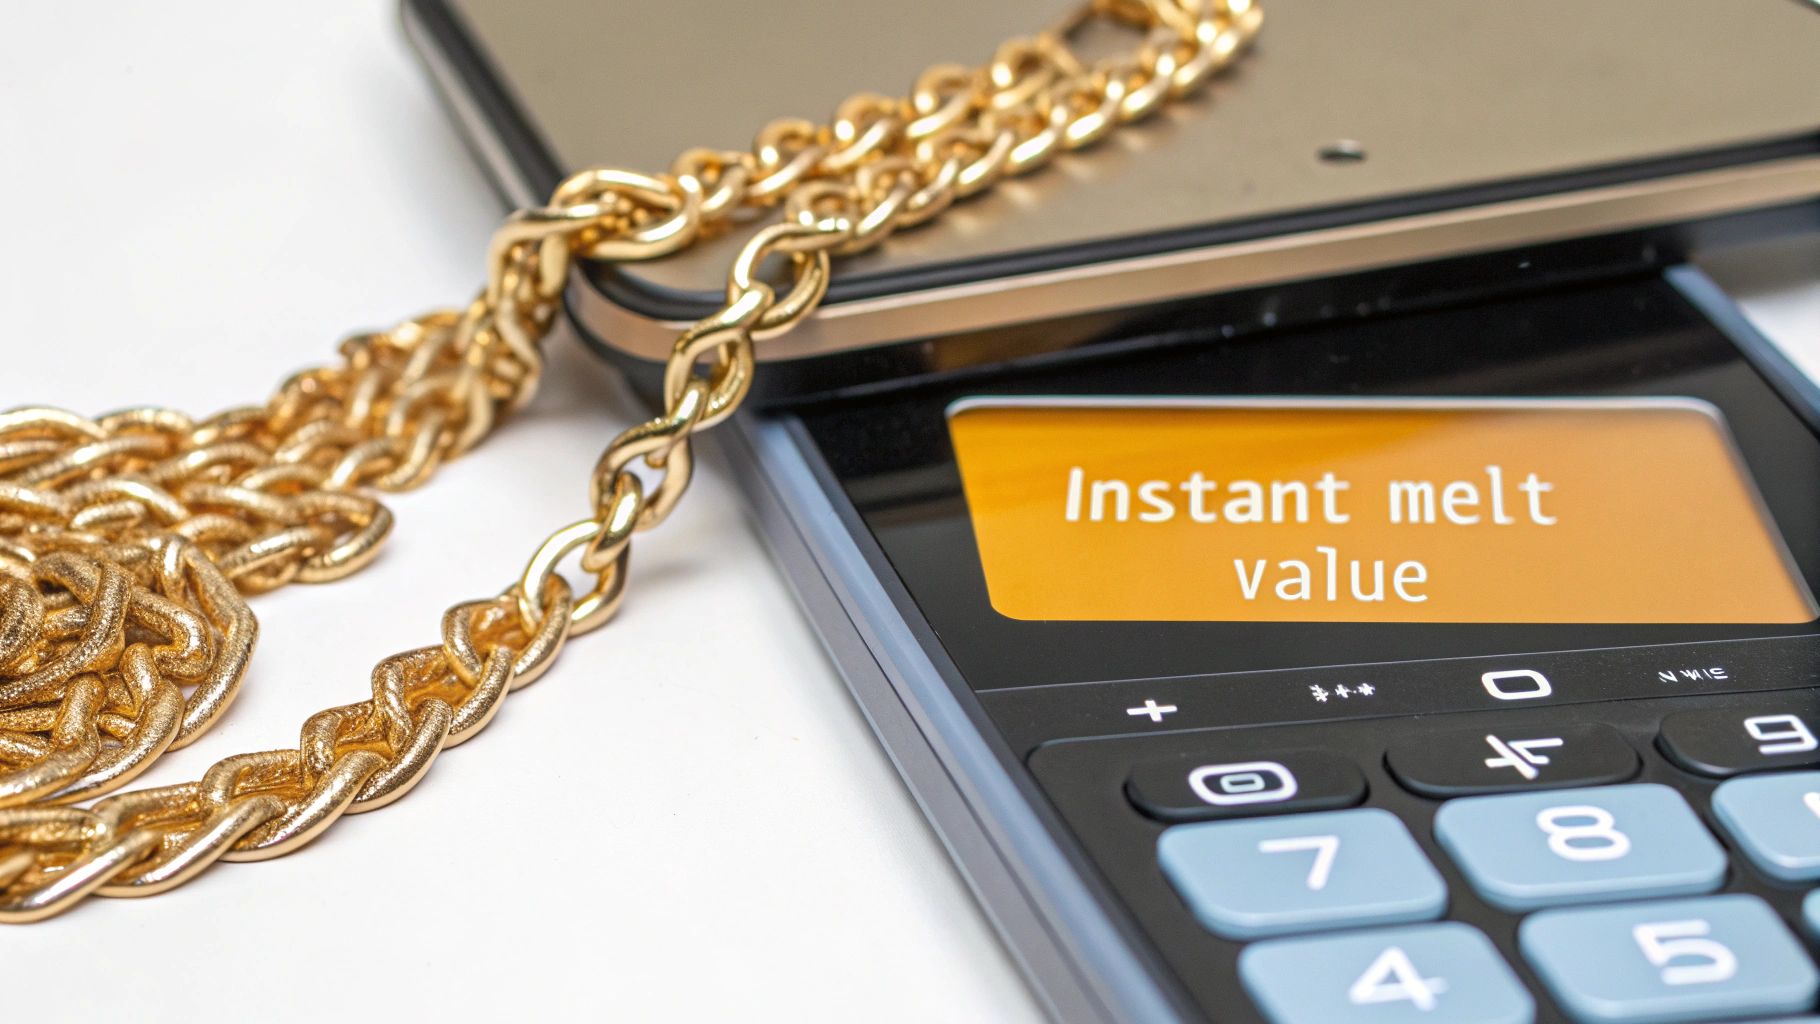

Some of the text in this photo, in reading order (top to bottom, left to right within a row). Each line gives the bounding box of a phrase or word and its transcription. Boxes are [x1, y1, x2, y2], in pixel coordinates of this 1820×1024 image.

[1064, 465, 1557, 526] Instant melt
[1233, 545, 1429, 603] value
[1258, 835, 1341, 891] 7
[1535, 805, 1631, 862] 8
[1348, 945, 1446, 1011] 4
[1632, 919, 1737, 985] 5
